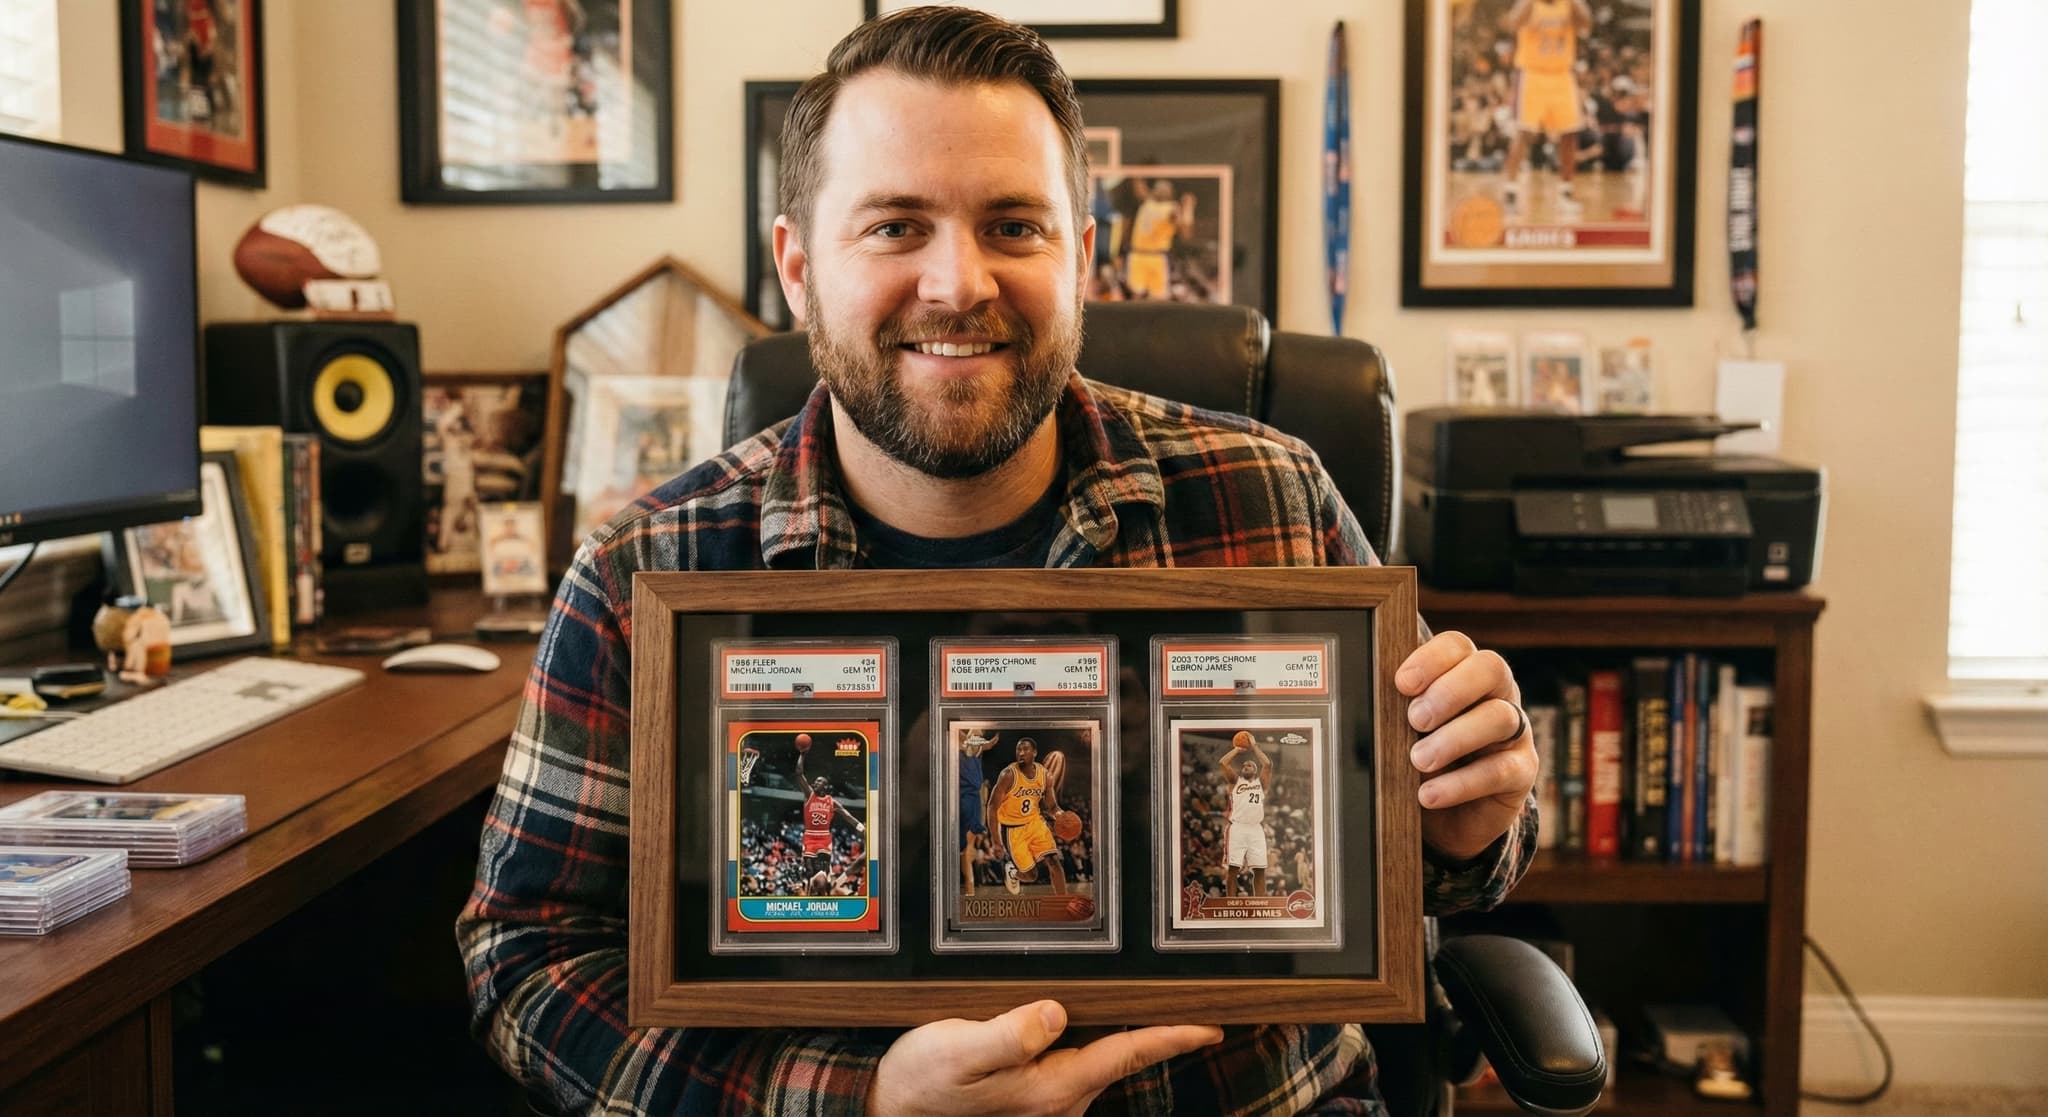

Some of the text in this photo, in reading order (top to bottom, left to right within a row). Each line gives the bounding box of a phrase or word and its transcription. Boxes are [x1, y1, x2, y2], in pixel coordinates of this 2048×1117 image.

[752, 658, 777, 667] FLEER
[974, 658, 1000, 666] TOPPS
[1002, 657, 1037, 666] CHROME
[1171, 655, 1257, 664] 2003 TOPPS CHROME
[730, 666, 802, 675] MICHAEL JORDAN
[842, 666, 861, 674] GEM
[974, 666, 1008, 674] BRYANT
[1064, 665, 1097, 673] GEM MT
[1171, 663, 1233, 672] LeBRON JAMES
[1285, 663, 1318, 671] GEM MT
[866, 674, 876, 682] 10
[1088, 673, 1098, 681] 10
[1309, 671, 1319, 679] 10
[1249, 792, 1260, 804] 23
[1021, 799, 1031, 814] 8
[766, 901, 839, 911] MICHAEL JORDAN
[965, 900, 1041, 917] KOBE BRYANT
